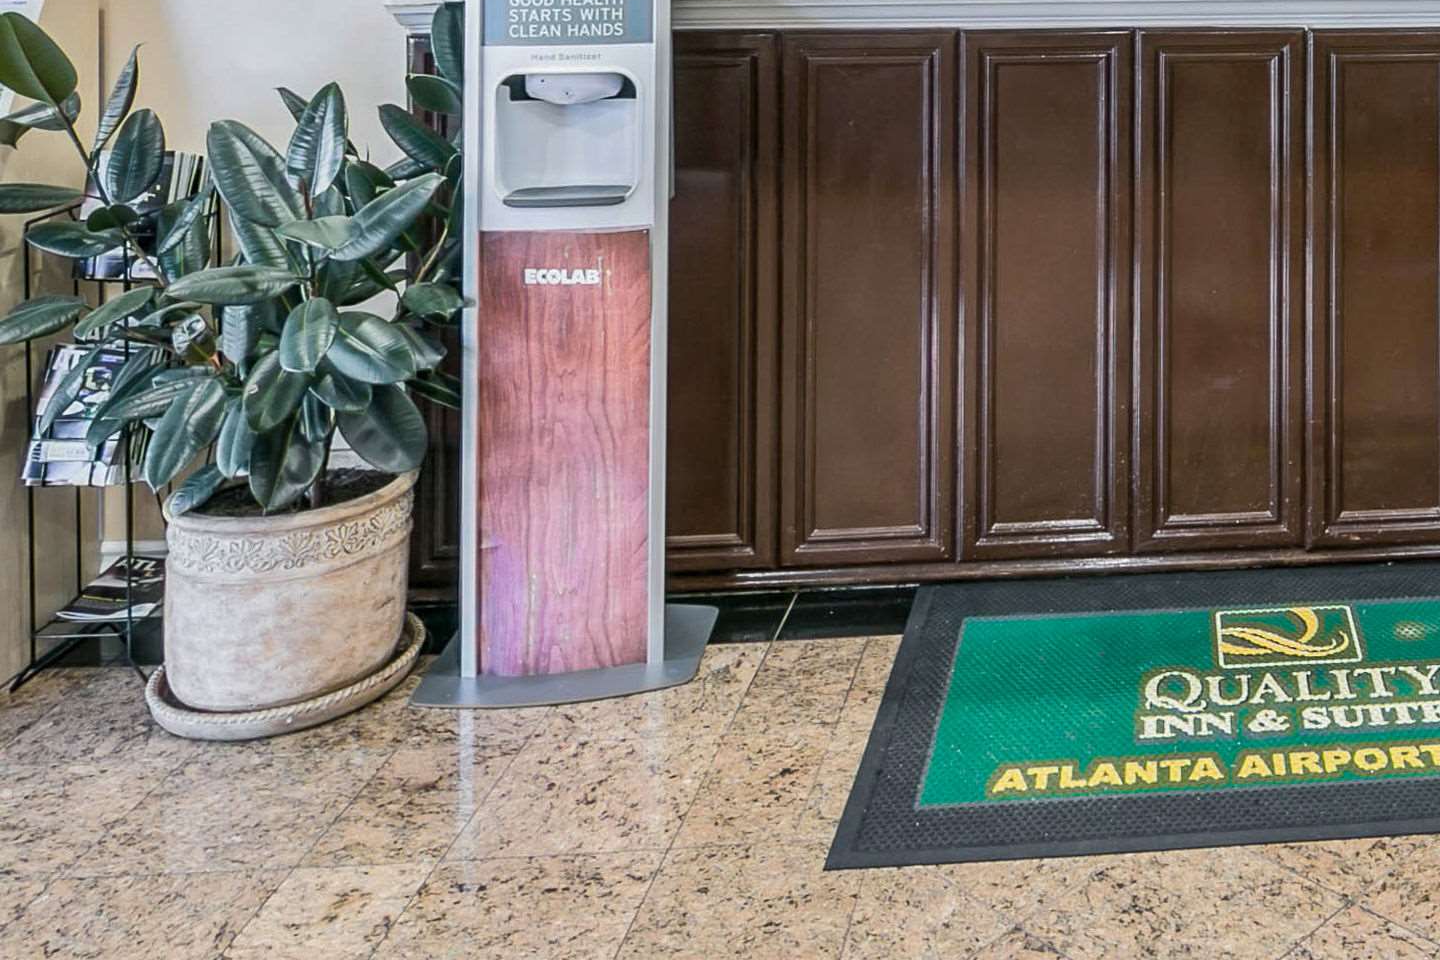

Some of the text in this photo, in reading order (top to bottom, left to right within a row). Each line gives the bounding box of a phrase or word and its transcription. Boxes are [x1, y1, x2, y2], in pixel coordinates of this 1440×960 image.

[509, 8, 623, 22] STARTS WITH
[508, 23, 624, 38] CLEAN HANDS
[524, 268, 600, 285] ECOLAB
[1138, 710, 1235, 739] INN
[1248, 708, 1290, 733] &
[992, 757, 1225, 794] ATLANTA
